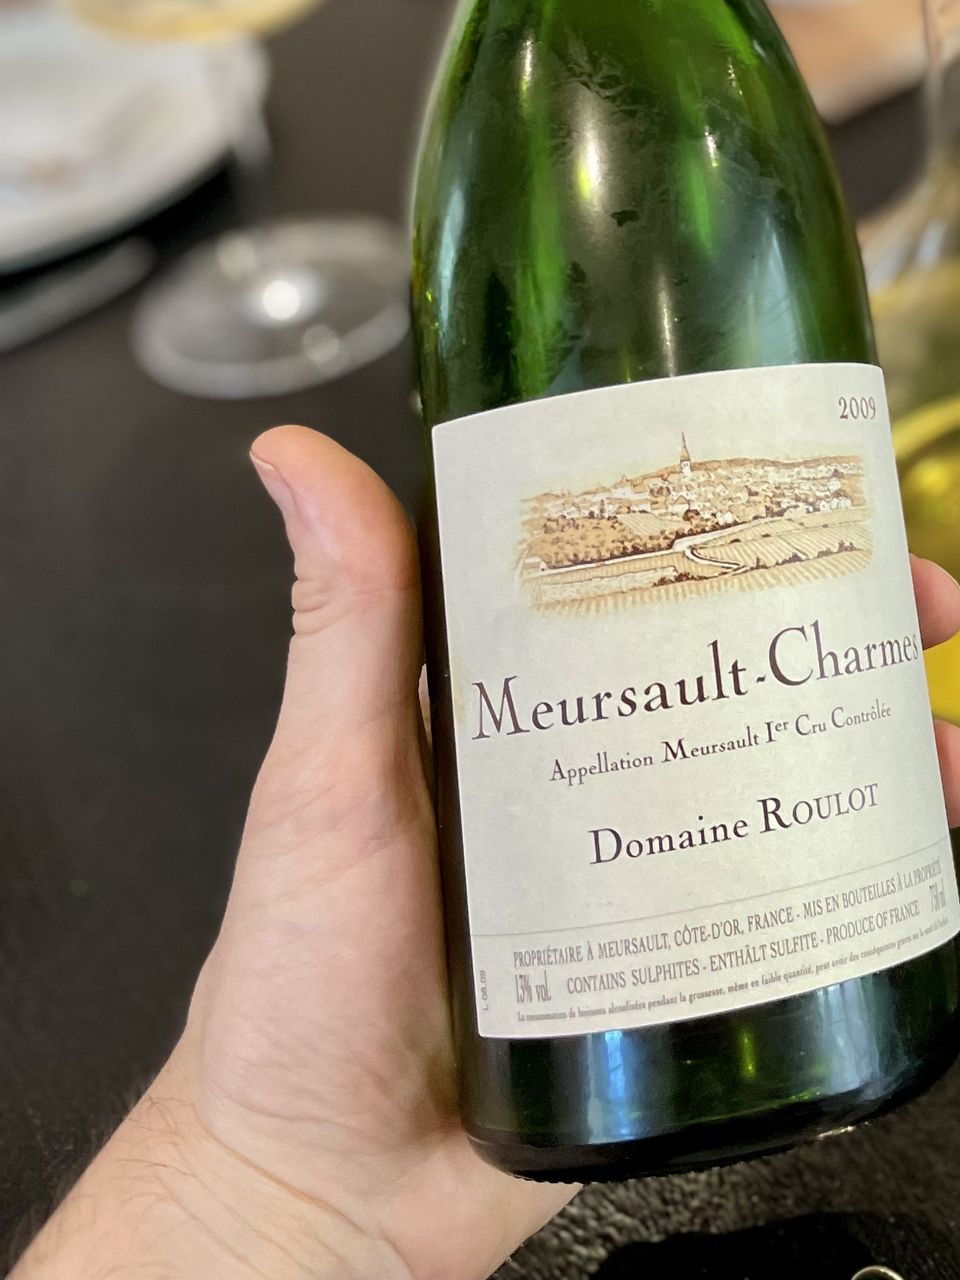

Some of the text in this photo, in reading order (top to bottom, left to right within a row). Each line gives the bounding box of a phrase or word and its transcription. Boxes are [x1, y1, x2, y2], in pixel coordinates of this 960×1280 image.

[838, 396, 876, 420] 2009
[471, 619, 919, 740] Meursault-Charmes
[550, 751, 653, 786] Appellation
[661, 726, 760, 763] Meursault
[794, 713, 827, 736] Cru
[831, 699, 892, 729] Contrôlée
[588, 783, 878, 865] Domaine ROULOT
[513, 944, 583, 968] PROPRIÉTAIRE
[586, 940, 594, 961] À
[598, 932, 671, 959] MEURSAULT,
[674, 919, 744, 947] CÔTE-D'OR,
[747, 907, 794, 932] FRANCE
[803, 897, 823, 919] MIS
[825, 893, 840, 913] EN
[842, 878, 896, 908] BOUTEILLES
[903, 871, 913, 889] LA
[567, 971, 626, 994] CONTAINS
[631, 958, 700, 986] SULPHITES
[709, 944, 767, 972] ENTHÄLT
[769, 932, 818, 958] SULFITE
[826, 916, 875, 944] PRODUCE
[876, 911, 888, 929] OF
[889, 900, 920, 925] FRANCE
